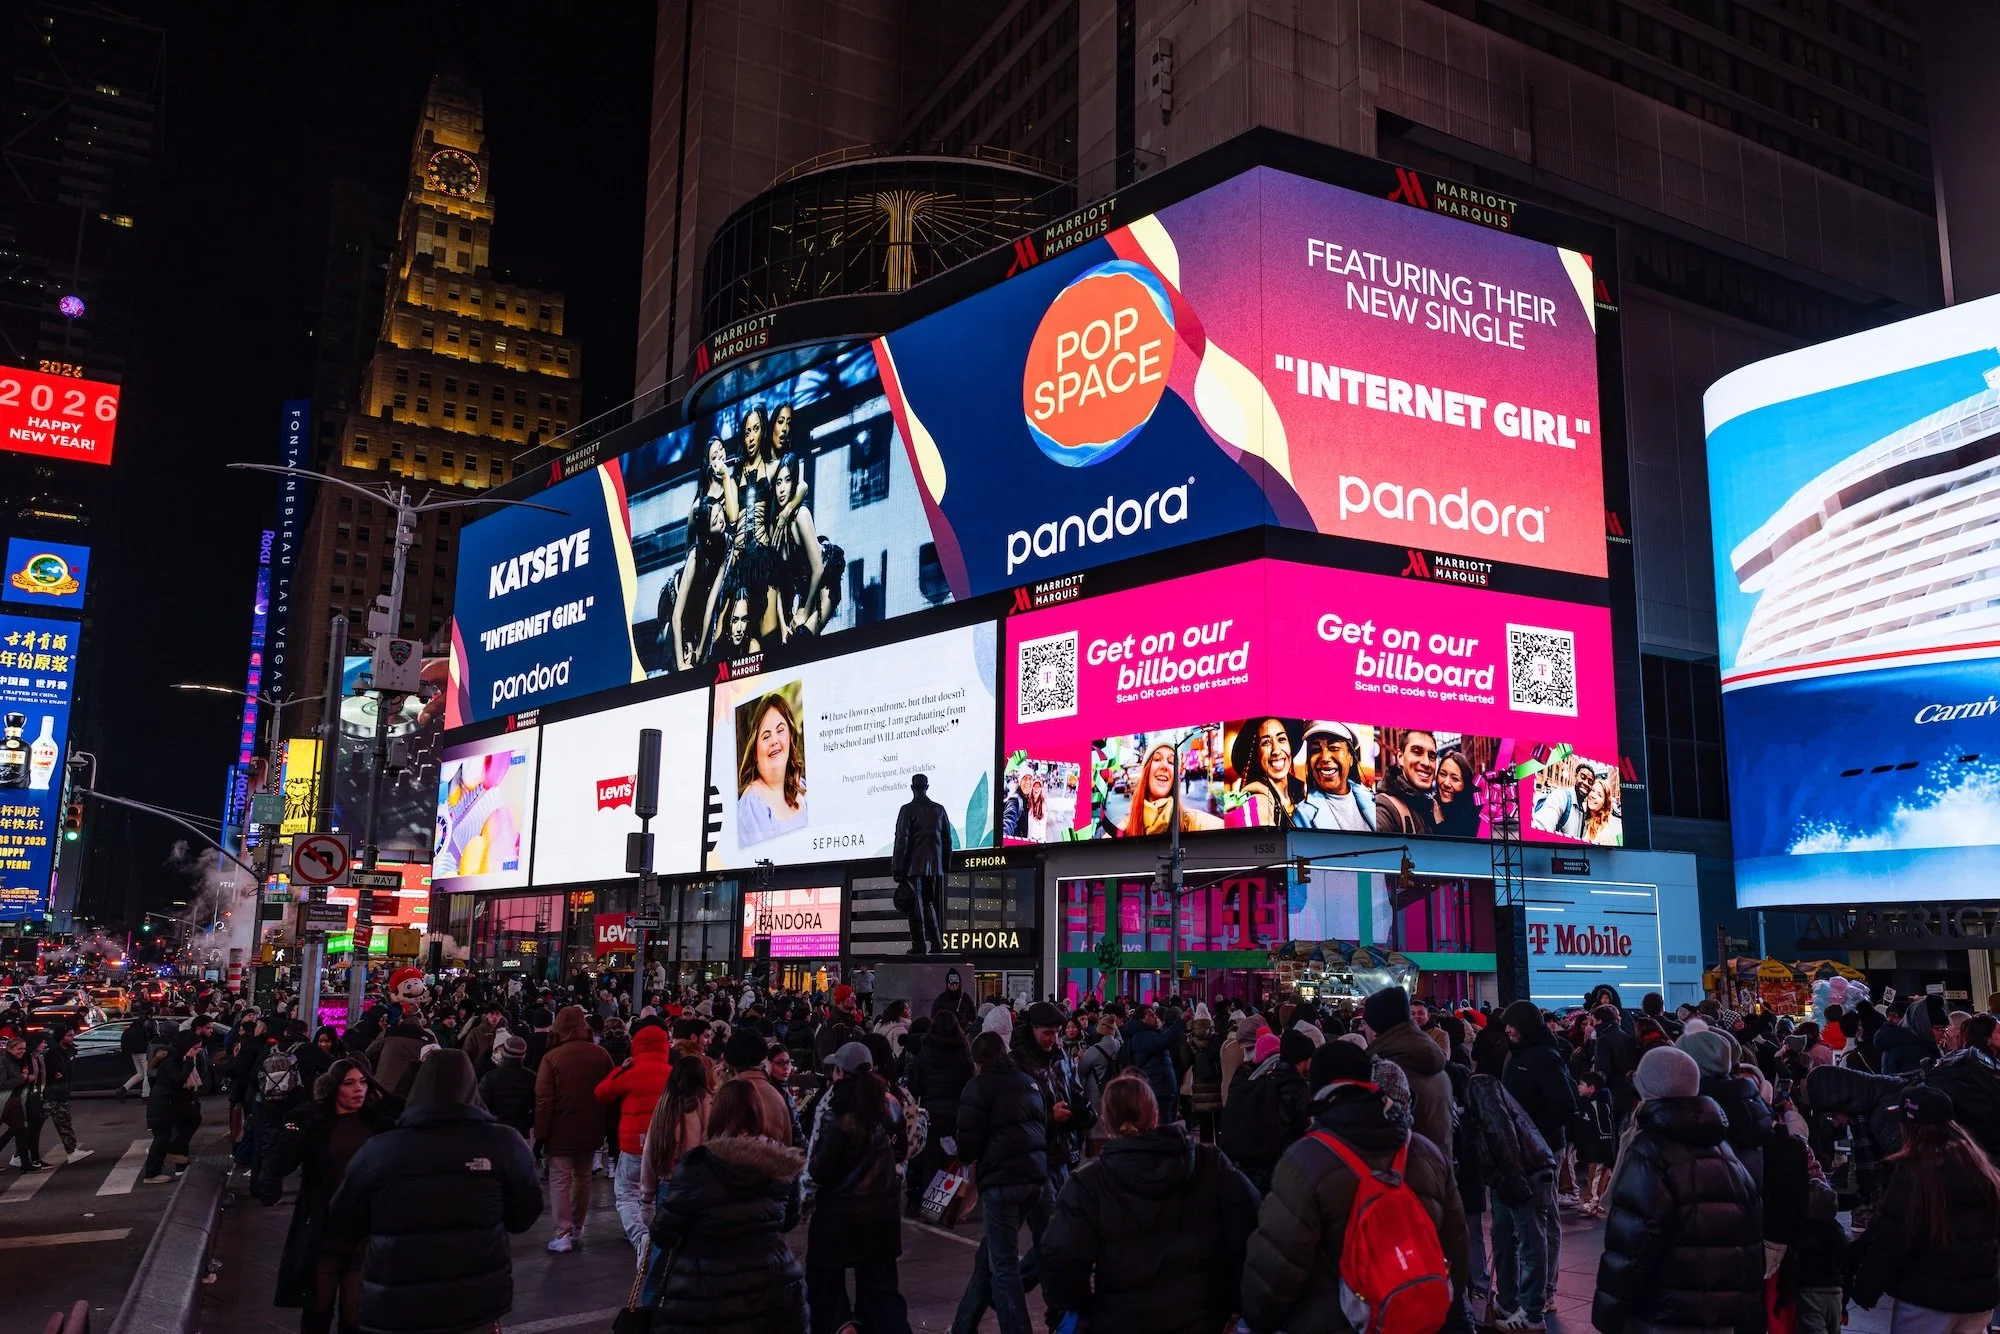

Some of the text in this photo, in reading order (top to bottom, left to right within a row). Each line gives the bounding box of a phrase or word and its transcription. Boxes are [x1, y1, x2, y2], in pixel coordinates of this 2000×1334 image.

[1436, 181, 1517, 214] MARRIOTT
[1046, 198, 1117, 240] MARRIOTT
[1436, 197, 1509, 228] MARQUIS
[1045, 219, 1108, 257] MARQUIS
[1307, 238, 1557, 327] FEATURING THEIR
[714, 313, 777, 348] MARRIOTT
[1346, 281, 1526, 351] NEW SINGLE
[713, 332, 766, 363] MARQUIS
[1056, 307, 1139, 373] POP
[1033, 339, 1162, 421] SPACE
[0, 379, 119, 422] 2026
[1275, 354, 1591, 450] "INTERNET GIRL"
[9, 428, 96, 450] NEW YEAR!
[27, 416, 82, 434] HAPPY
[564, 456, 596, 476] MARQUIS
[565, 442, 600, 464] MARRIOTT
[1338, 474, 1546, 544] pandora
[1007, 484, 1188, 576] pandora
[272, 410, 300, 693] FONTAINEBLEAU LAS VEGAS
[488, 528, 591, 600] KATSEYE
[1434, 556, 1493, 574] MARRIOTT
[1035, 574, 1085, 594] MARRIOTT
[1434, 568, 1487, 585] MARQUIS
[1035, 587, 1080, 606] MARQUIS
[480, 595, 594, 652] "INTERNET GIRL"
[1316, 613, 1479, 658] Get on our
[1086, 619, 1233, 666] Get on our
[731, 664, 760, 678] MARQUIS
[732, 653, 765, 668] MARRIOTT
[1116, 641, 1250, 691] billboard
[1355, 649, 1495, 690] billboard
[491, 660, 570, 709] pandora
[1116, 673, 1249, 704] Scan QR code to get started
[1354, 680, 1495, 705] Scan QR code to get started
[819, 729, 834, 739] stop
[834, 727, 845, 736] me
[845, 724, 863, 734] from
[888, 716, 892, 726] I
[892, 716, 904, 726] am
[904, 708, 946, 726] graduating
[946, 704, 966, 716] from
[833, 712, 848, 721] have
[848, 708, 869, 720] Down
[908, 697, 920, 708] but
[921, 693, 937, 705] that
[823, 741, 839, 753] high
[839, 737, 862, 749] school
[862, 734, 876, 746] and
[876, 731, 895, 742] WILL
[896, 727, 920, 740] attend
[842, 774, 866, 784] Program
[899, 765, 912, 775] Best
[912, 762, 936, 773] Buddies
[867, 781, 908, 796] @bestbuddies
[12, 836, 23, 845] TO
[24, 836, 47, 846] 2026
[813, 834, 865, 850] SEPHORA
[1253, 844, 1276, 854] 1535
[6, 860, 32, 870] YEAR!
[964, 856, 1007, 868] SEPHORA
[351, 875, 393, 885] NE WAY
[759, 912, 822, 932] PANDORA
[942, 931, 1020, 950] SEPHORA
[1554, 924, 1632, 957] Mobile
[921, 1200, 943, 1214] GIFTS
[927, 1187, 951, 1203] NY
